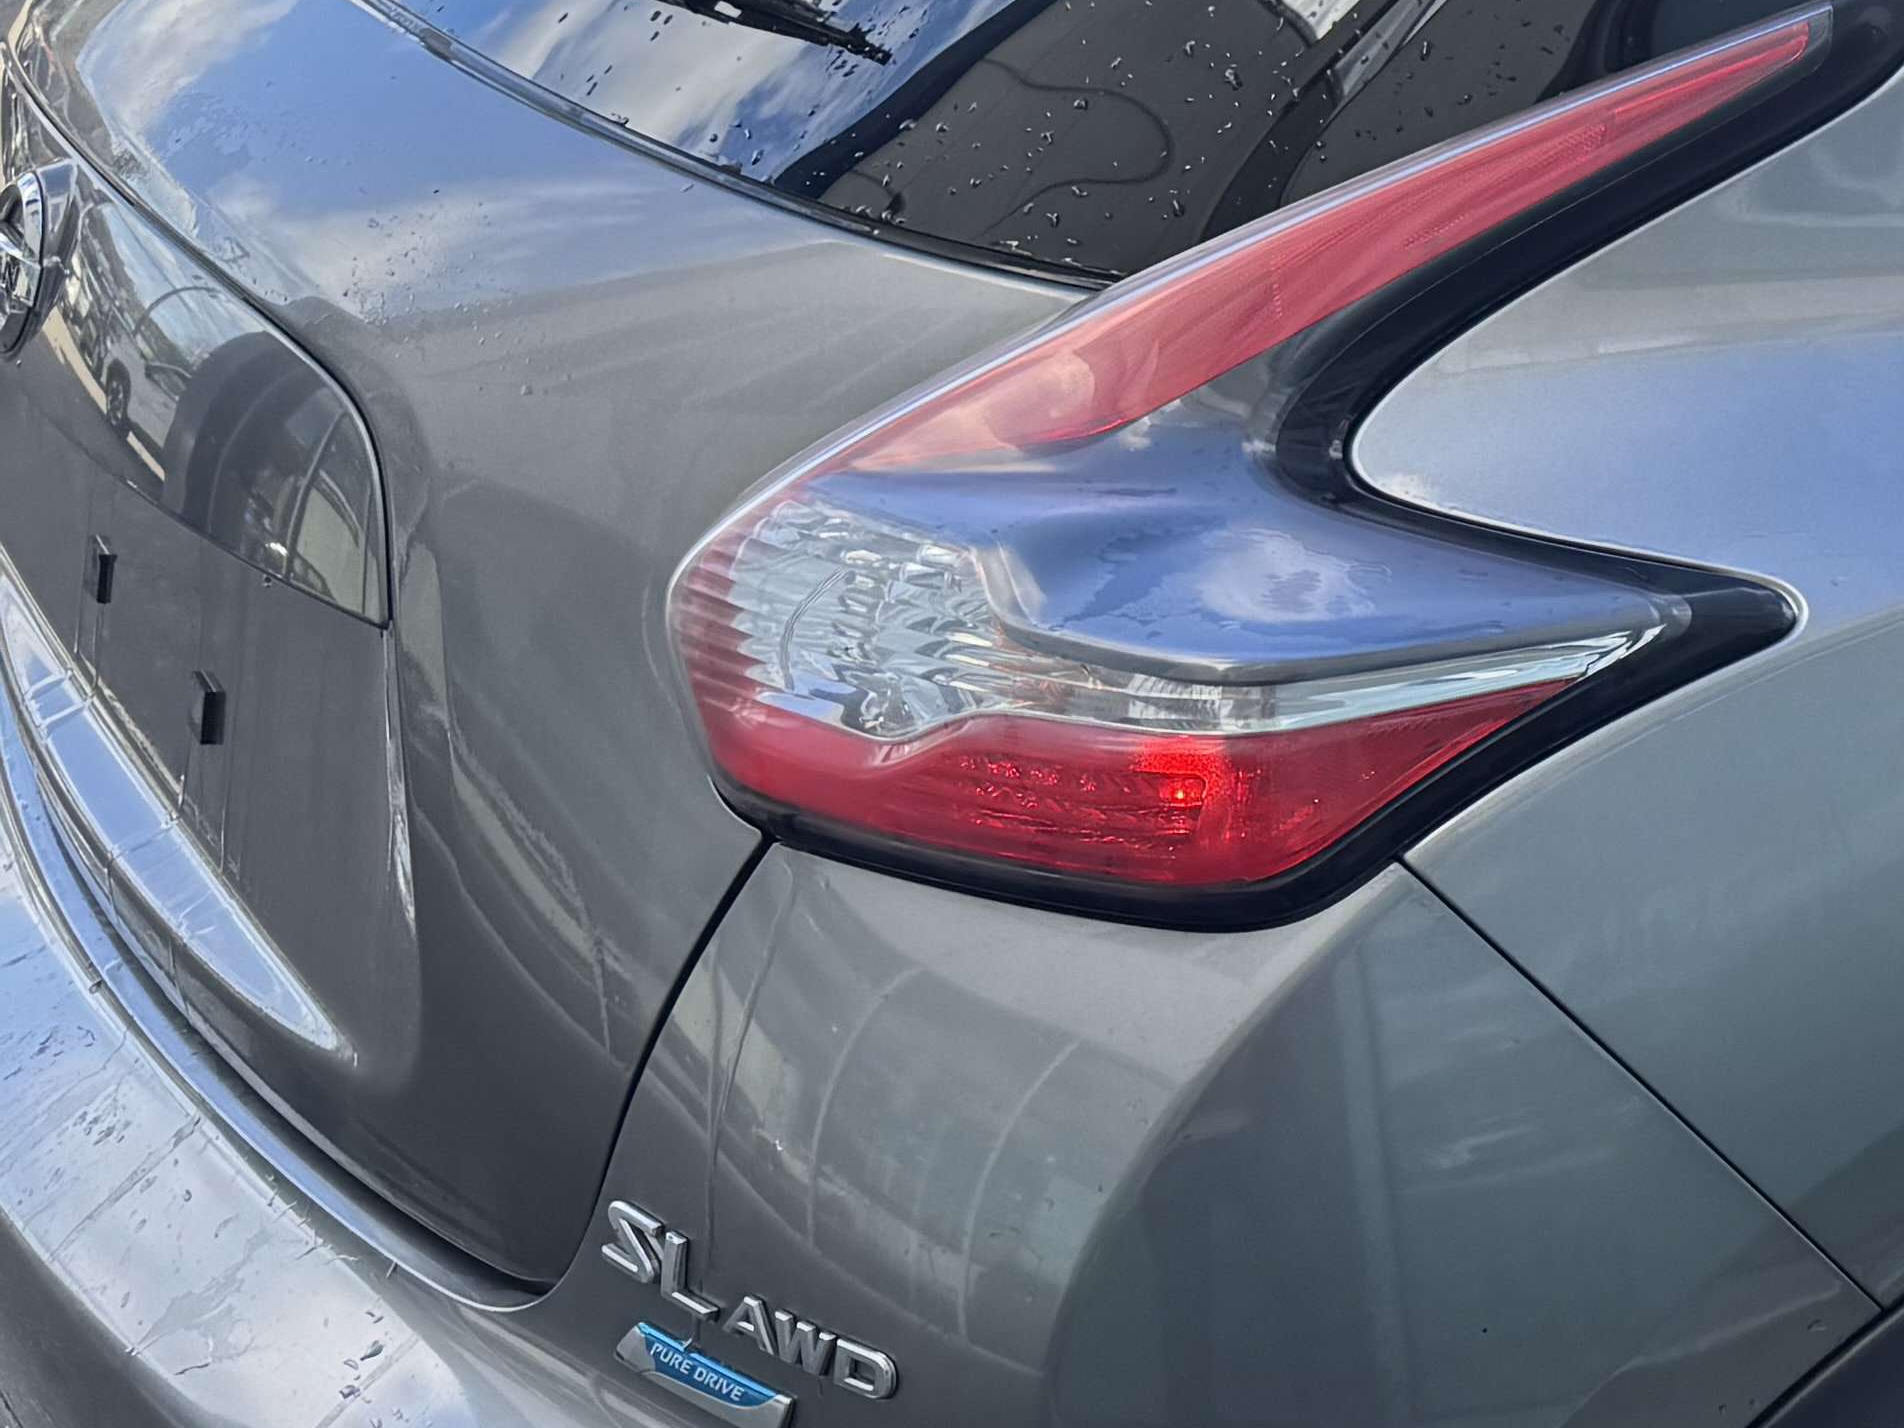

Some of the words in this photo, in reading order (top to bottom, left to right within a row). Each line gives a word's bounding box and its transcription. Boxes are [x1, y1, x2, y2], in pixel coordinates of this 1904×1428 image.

[601, 1200, 719, 1322] SL
[722, 1294, 899, 1400] AWD
[650, 1342, 693, 1375] PURE
[693, 1366, 745, 1402] DRIVE
